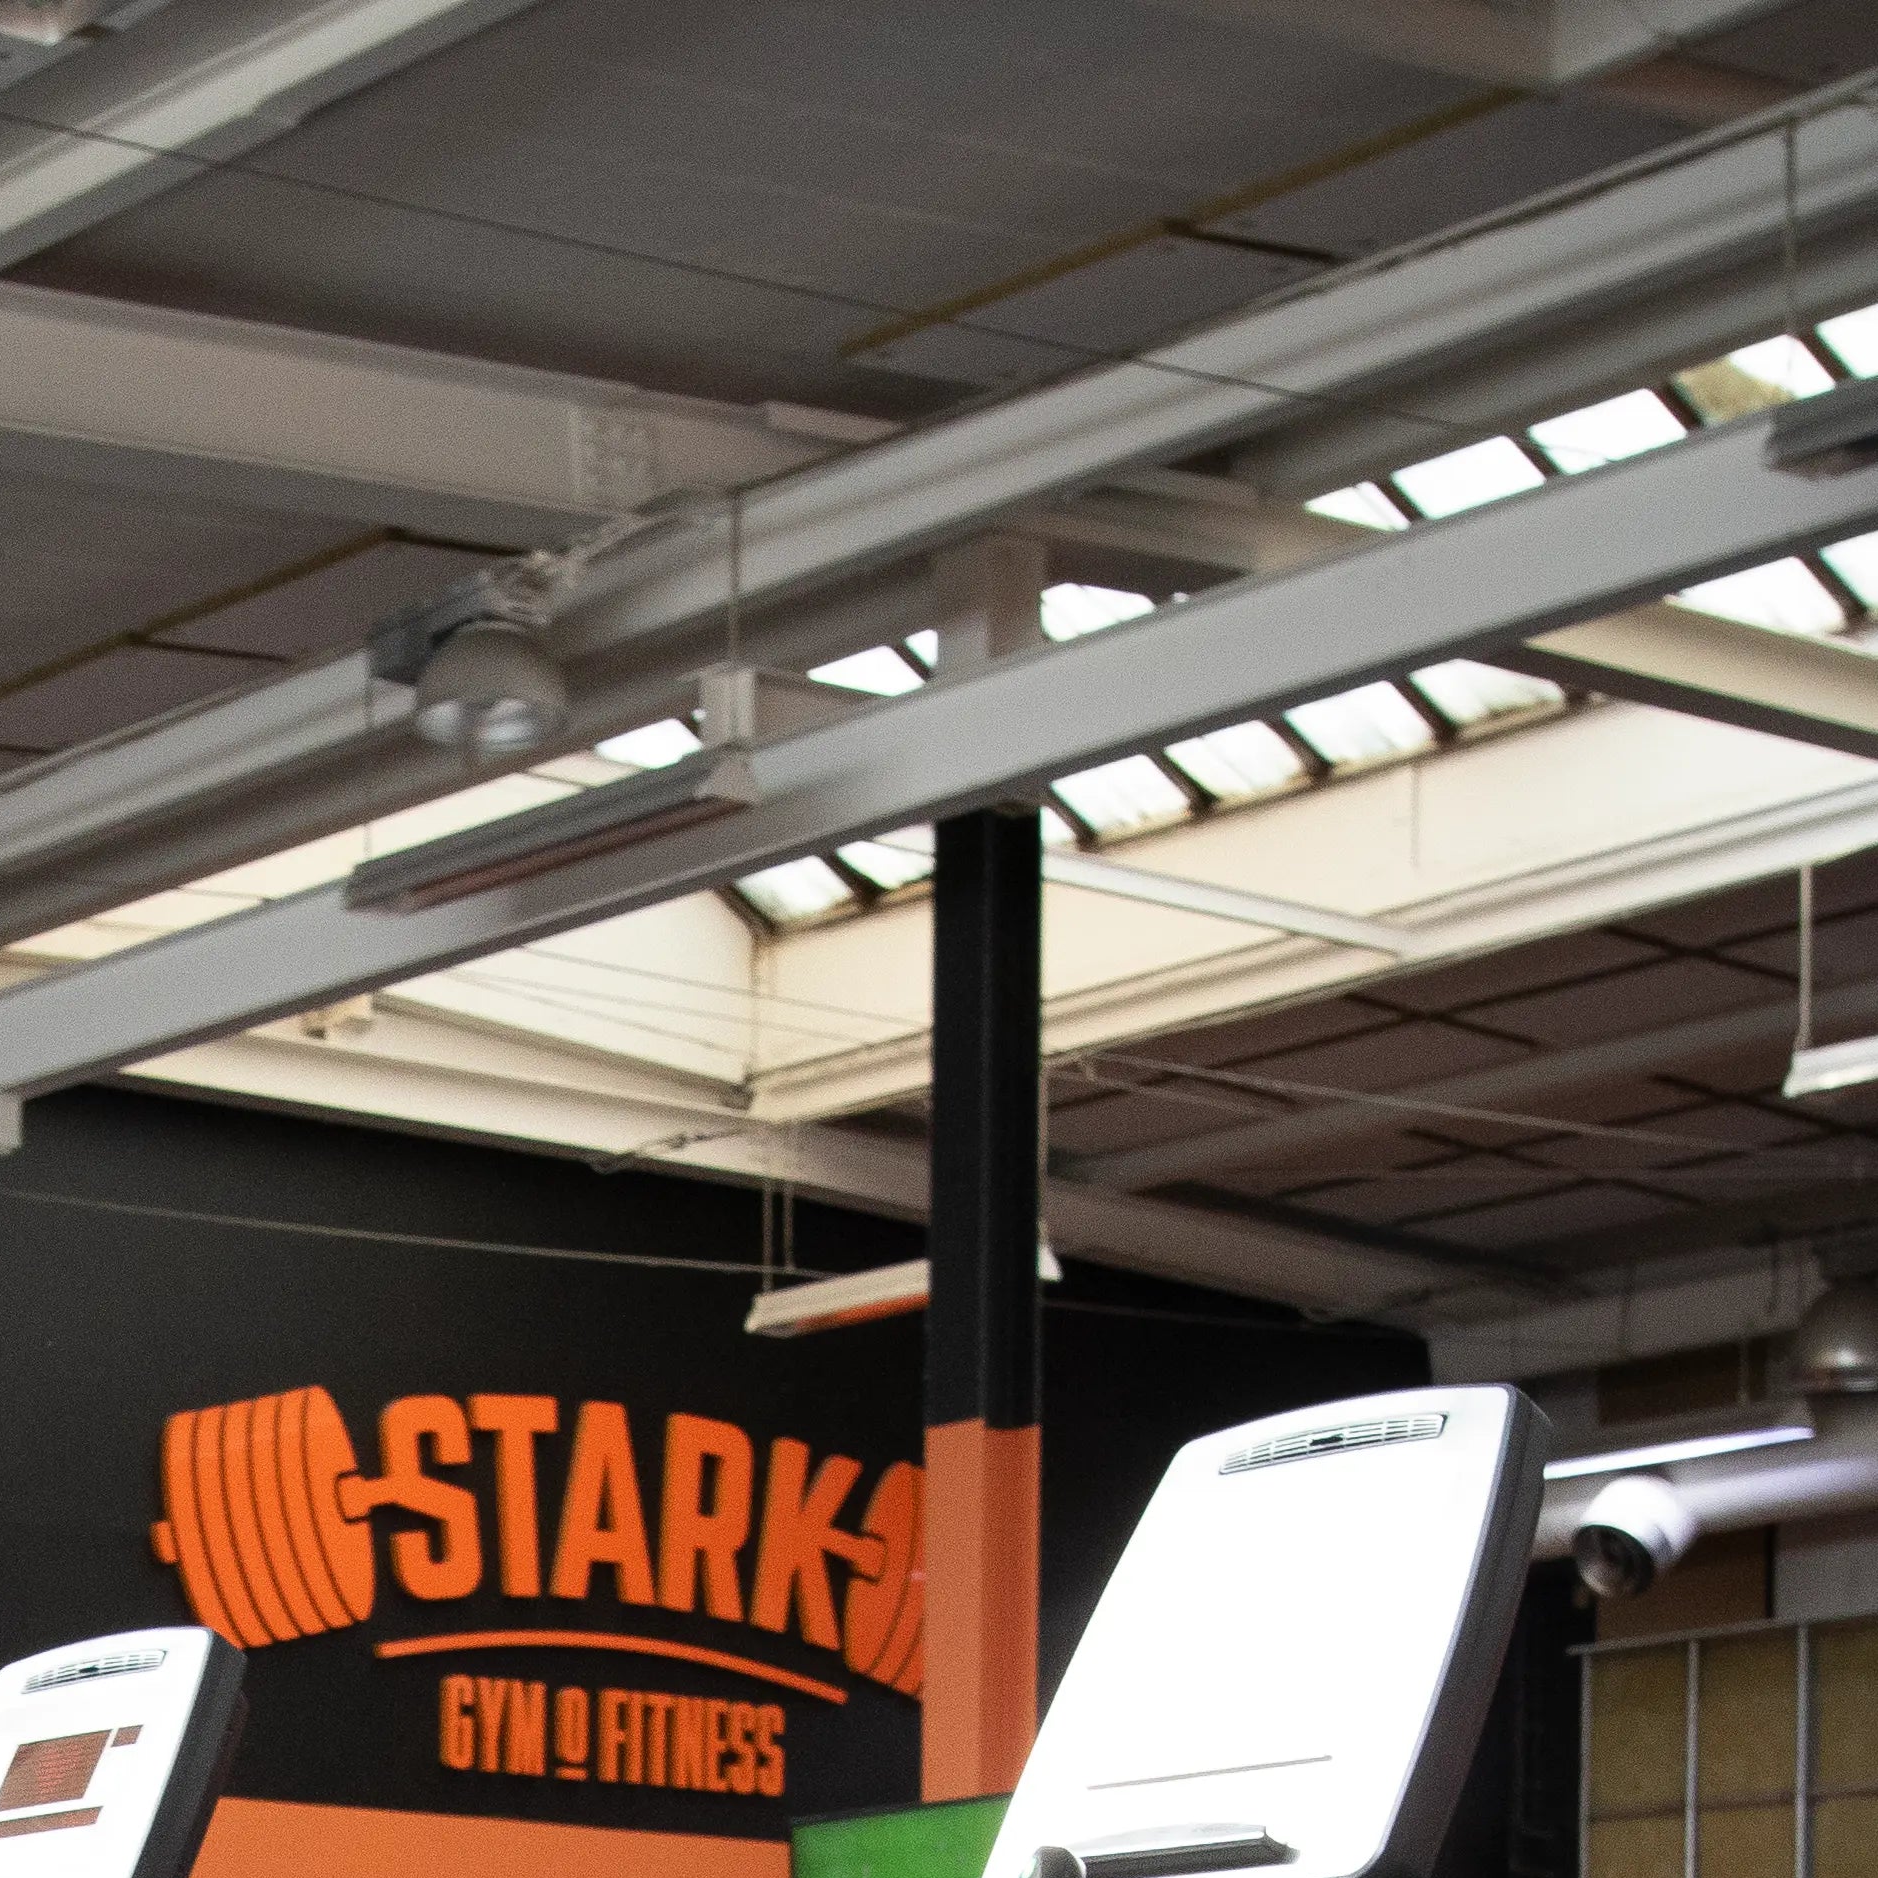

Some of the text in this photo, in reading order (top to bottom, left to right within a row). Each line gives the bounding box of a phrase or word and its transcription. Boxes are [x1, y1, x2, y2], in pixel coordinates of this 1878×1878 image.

[378, 1393, 863, 1651] STARK
[440, 1673, 547, 1777] GYM
[597, 1686, 786, 1797] FITNESS
